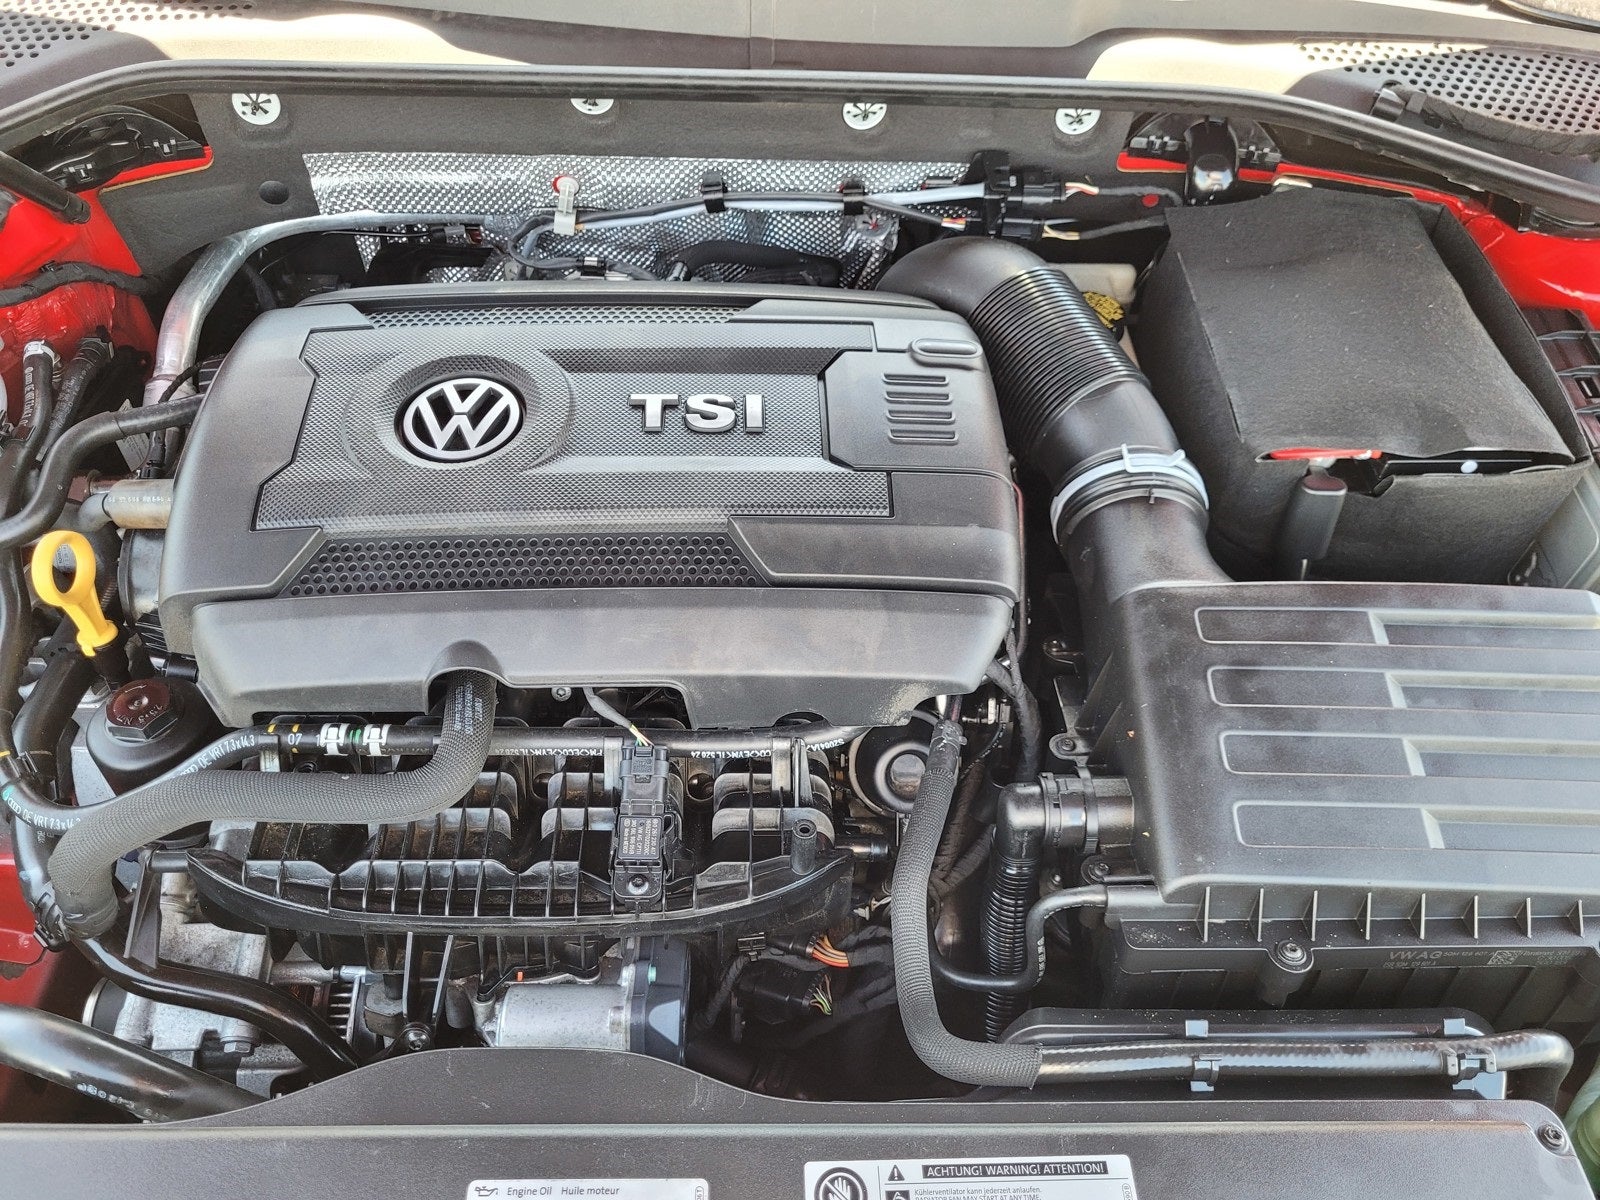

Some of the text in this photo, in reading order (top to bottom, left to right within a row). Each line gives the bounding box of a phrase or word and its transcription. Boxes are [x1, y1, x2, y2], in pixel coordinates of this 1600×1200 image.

[629, 393, 767, 434] TSI
[287, 733, 303, 745] 07
[209, 744, 226, 761] VRT
[33, 814, 48, 828] VRT
[1389, 951, 1417, 960] VW
[926, 1162, 1104, 1177] ACHTUNG! WARNING! ATTENTION!
[507, 1185, 552, 1198] Engine Oil
[561, 1185, 620, 1196] Huile moteur
[914, 1187, 965, 1196] Kühlerventilator
[966, 1187, 982, 1195] kann
[983, 1187, 1011, 1195] jederzeit
